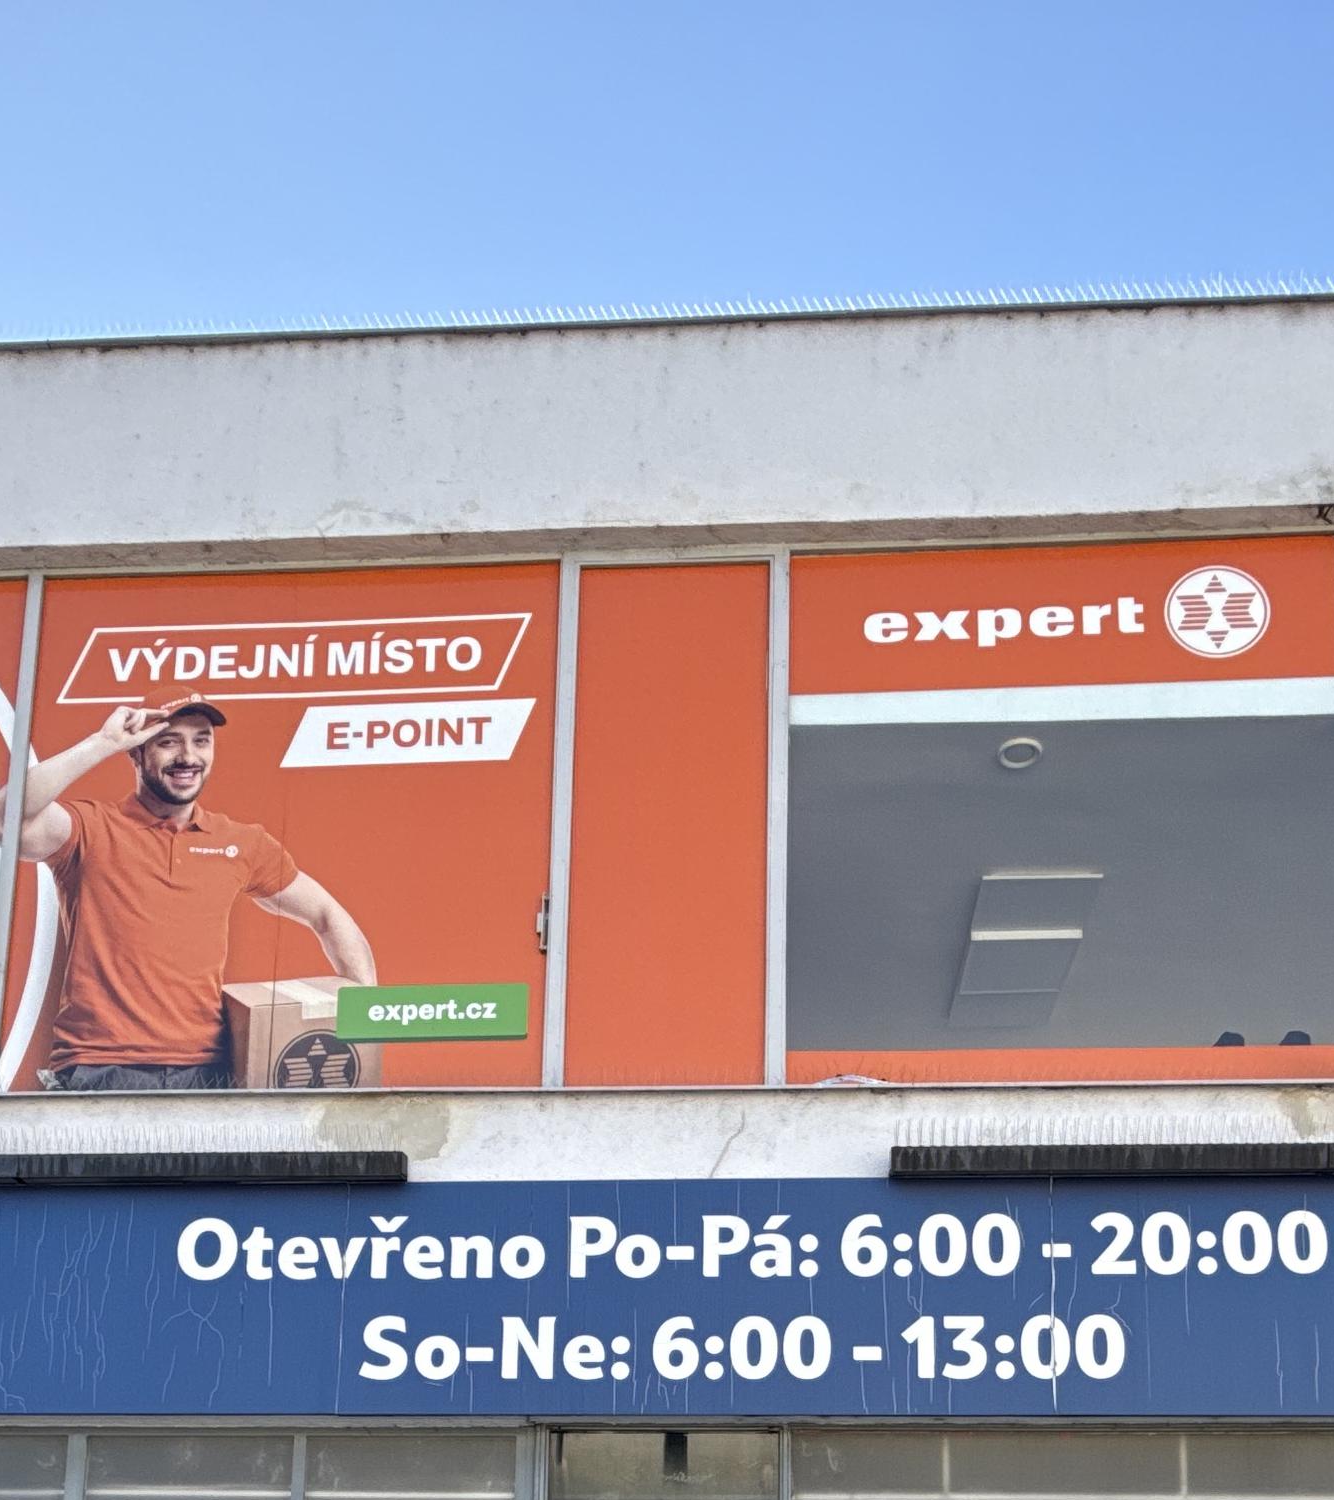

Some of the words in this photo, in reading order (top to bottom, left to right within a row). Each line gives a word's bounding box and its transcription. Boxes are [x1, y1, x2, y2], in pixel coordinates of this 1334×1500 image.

[863, 596, 1145, 647] expert
[108, 634, 319, 682] VÝDEJNÍ
[327, 631, 482, 676] MÍSTO
[326, 716, 492, 750] E-POINT
[368, 999, 497, 1026] expert.cz
[176, 1215, 546, 1281] Otevřeno
[569, 1213, 819, 1278] Po-Pá:
[841, 1213, 1021, 1278] 6:00
[1041, 1243, 1072, 1258] -
[1090, 1210, 1329, 1276] 20:00
[358, 1314, 630, 1381] So-Ne:
[652, 1314, 832, 1381] 6:00
[852, 1345, 883, 1361] -
[900, 1314, 1127, 1380] 13:00
